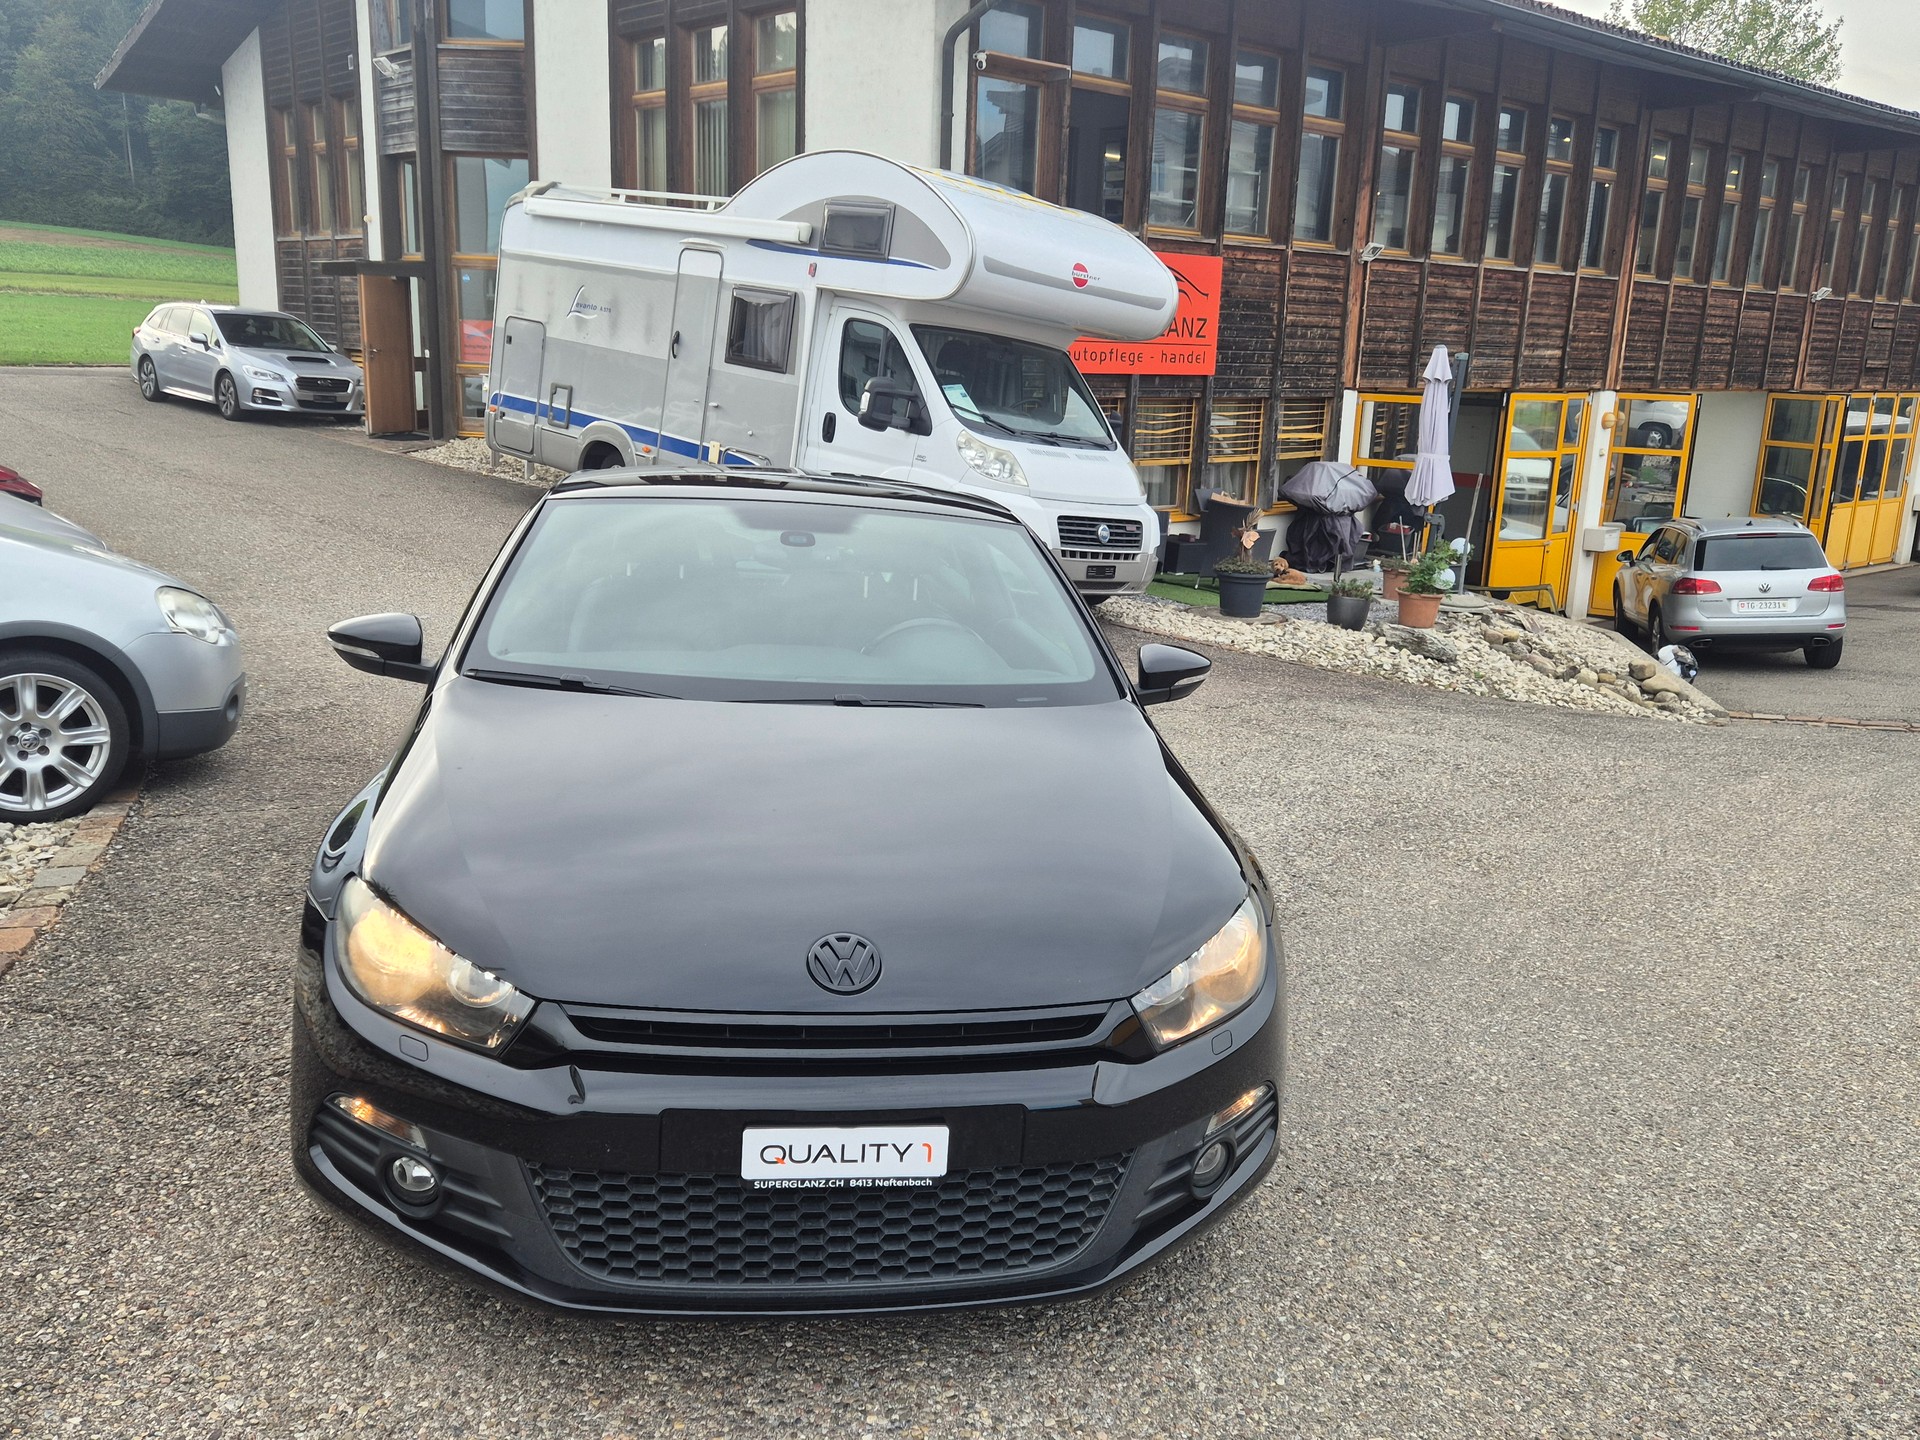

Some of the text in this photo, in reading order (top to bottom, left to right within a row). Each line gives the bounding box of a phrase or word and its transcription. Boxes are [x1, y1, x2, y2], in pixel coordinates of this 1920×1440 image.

[1071, 270, 1101, 281] bürstner
[1161, 350, 1206, 364] handel
[759, 1143, 932, 1164] QUALITY 1
[753, 1178, 933, 1189] SUPERGLANZ.CH 8413 Neftenbach
